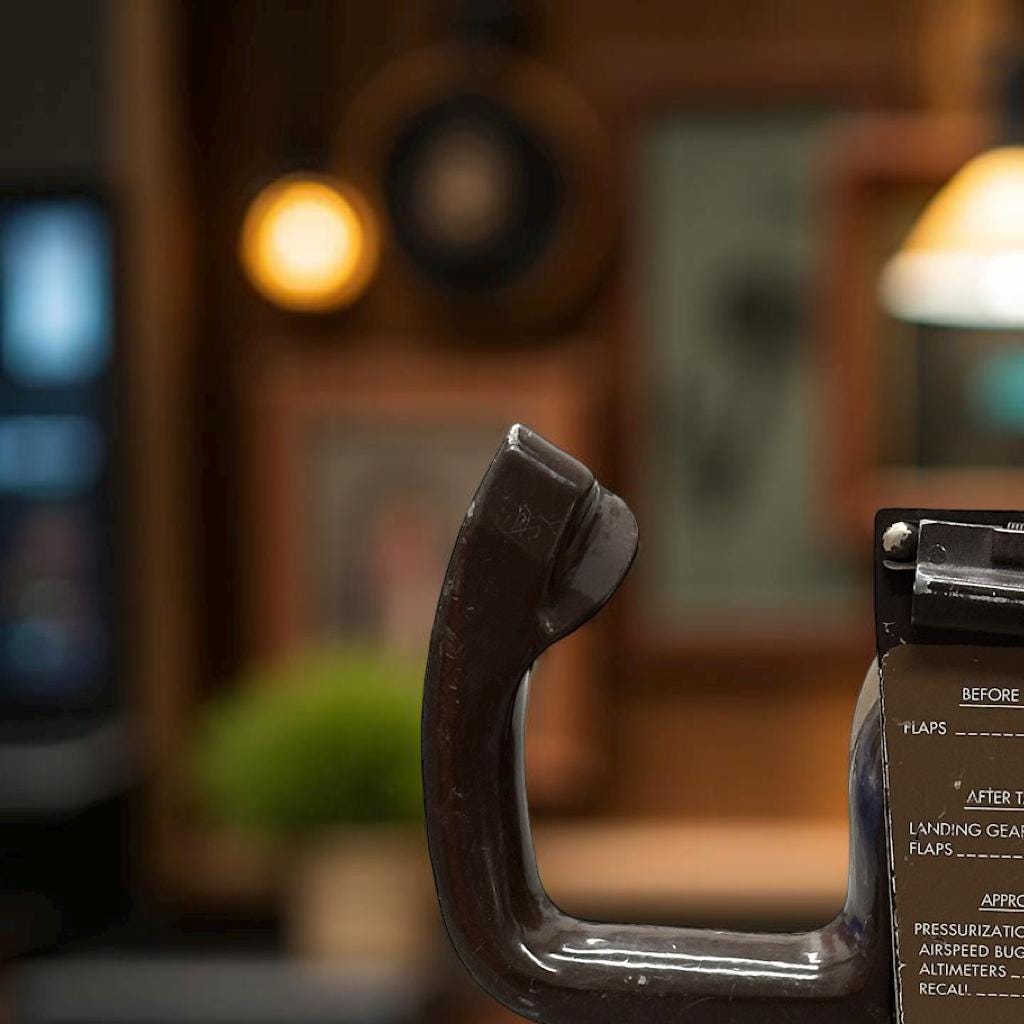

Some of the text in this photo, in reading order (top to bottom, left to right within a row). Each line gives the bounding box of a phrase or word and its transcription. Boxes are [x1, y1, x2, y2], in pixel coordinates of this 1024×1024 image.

[962, 687, 1019, 702] BEFORE
[903, 721, 947, 735] FLAPS
[966, 788, 1010, 804] AFTER
[909, 822, 981, 837] LANDING
[909, 842, 953, 856] FLAPS
[918, 944, 989, 957] AIRSPEED
[919, 963, 1007, 978] ALTIMETERS
[919, 983, 971, 996] RECALL
